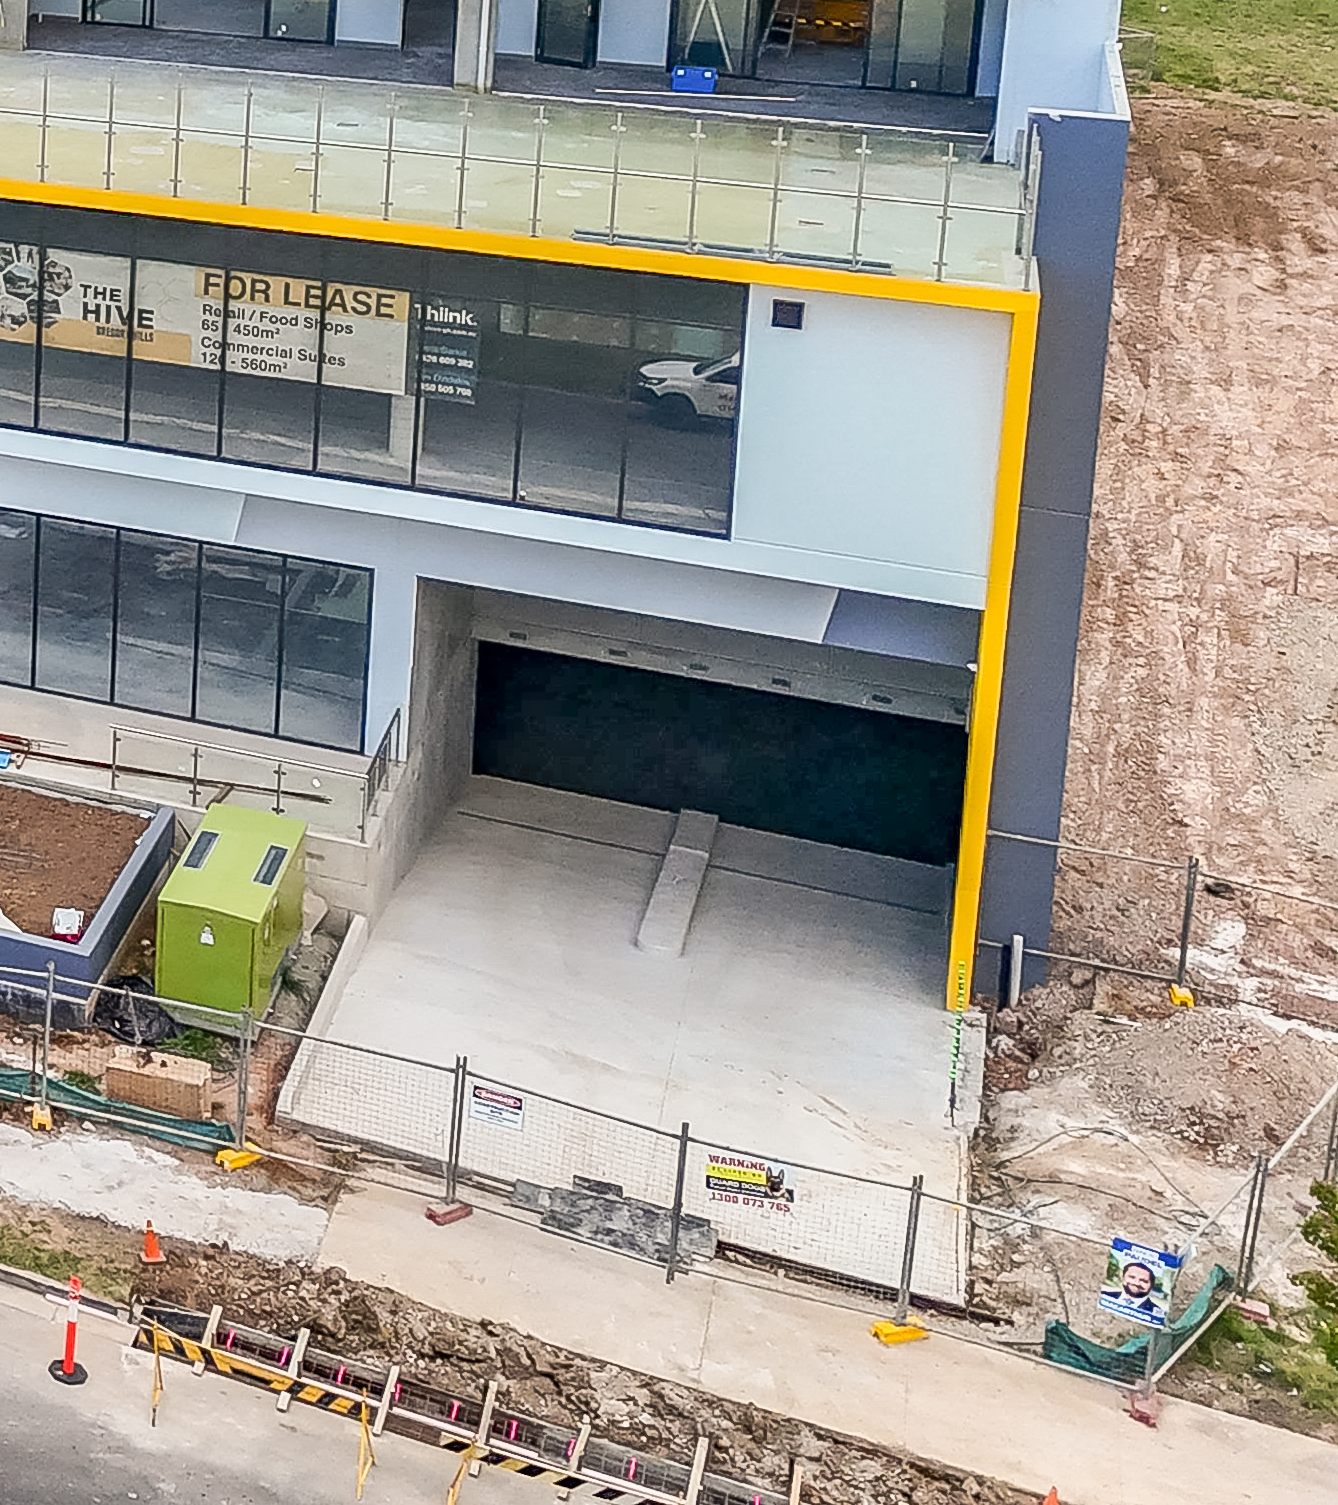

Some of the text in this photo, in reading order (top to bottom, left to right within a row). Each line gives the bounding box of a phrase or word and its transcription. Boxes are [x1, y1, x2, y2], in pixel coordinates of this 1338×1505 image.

[79, 283, 123, 303] THE
[202, 272, 397, 320] FOR LEASE
[81, 301, 156, 330] HIVE
[201, 303, 246, 322] Reail
[259, 311, 300, 327] Food
[303, 316, 355, 335] Shops
[201, 318, 281, 340] 65 450m²
[200, 336, 347, 367] Commercial Sutes
[239, 357, 289, 374] 560m²
[708, 1154, 766, 1171] WARNING
[709, 1191, 739, 1204] 1300
